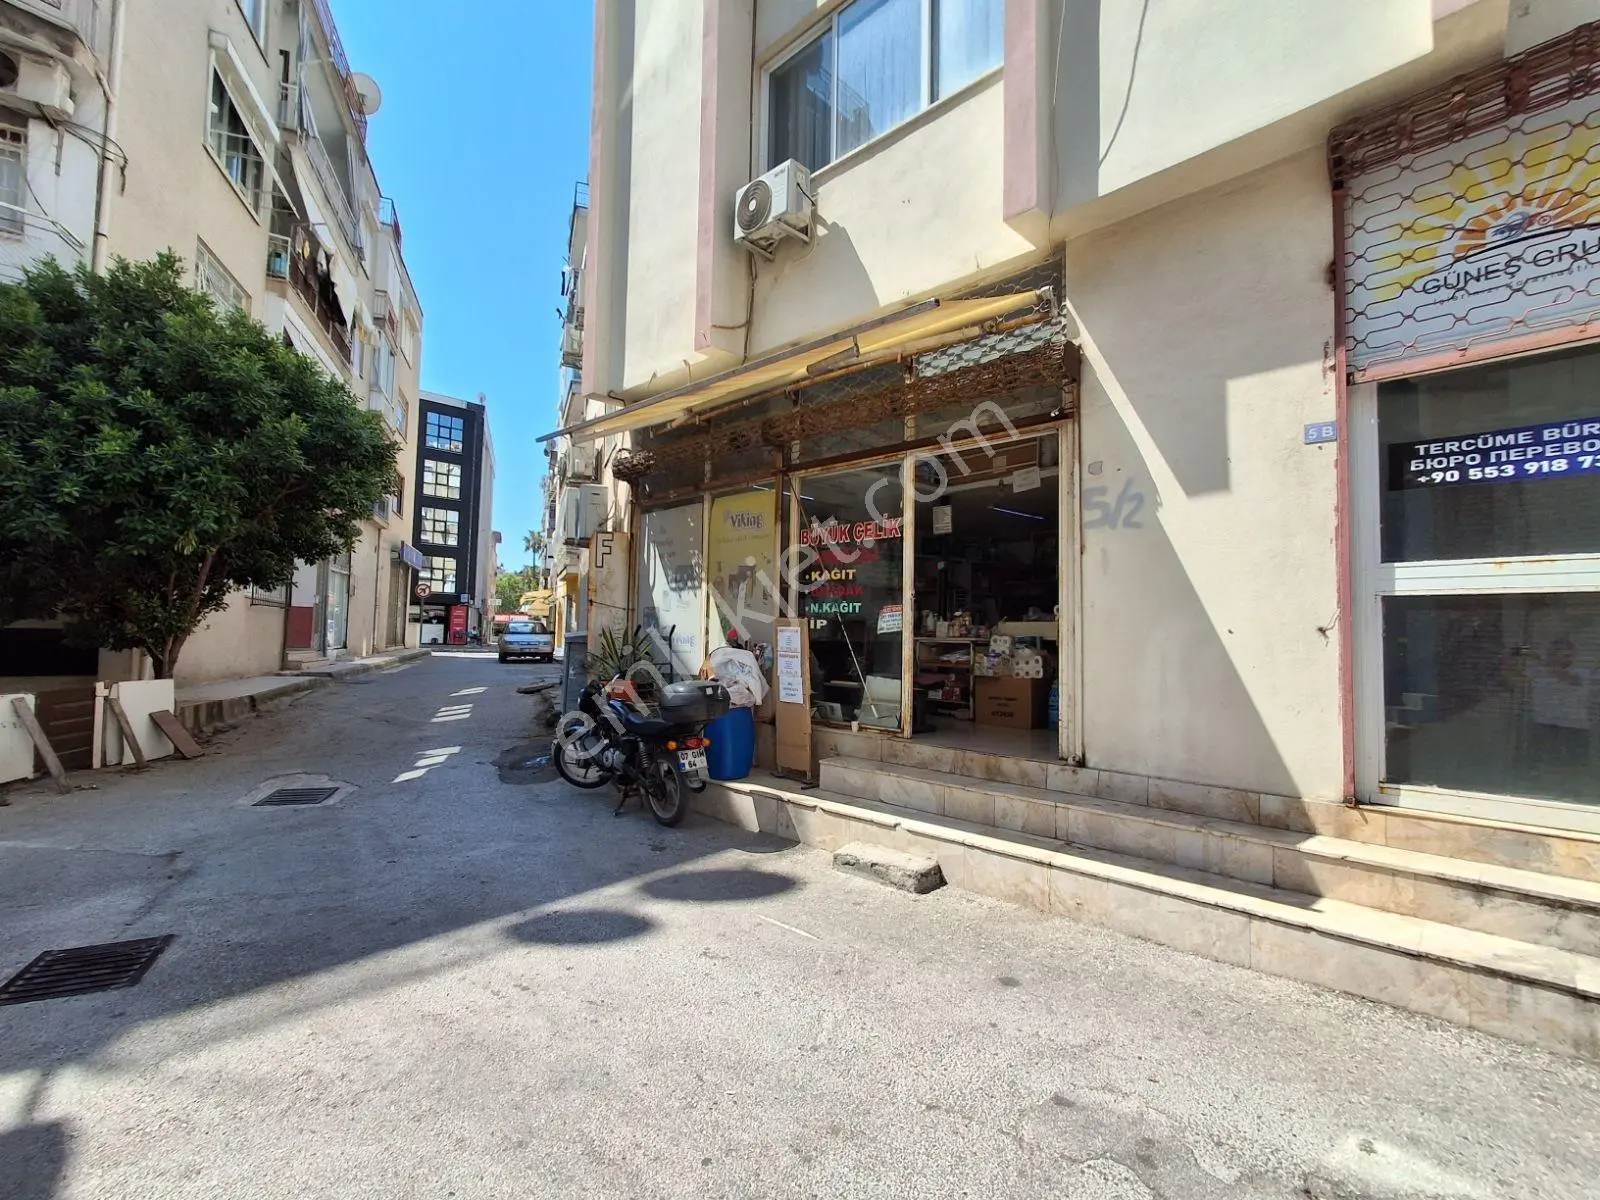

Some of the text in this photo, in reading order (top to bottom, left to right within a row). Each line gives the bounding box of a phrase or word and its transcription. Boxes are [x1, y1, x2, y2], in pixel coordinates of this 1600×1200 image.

[1423, 257, 1522, 295] GÜNEŞ
[1308, 426, 1333, 439] 5 B
[1415, 422, 1600, 456] TERCÜME BÜR
[1410, 438, 1600, 472] БЮРО ПЕРЕВО
[1417, 470, 1460, 484] +90
[1468, 464, 1515, 480] 553
[1523, 457, 1569, 474] 918
[800, 521, 851, 547] BÜYÜK
[852, 513, 903, 546] ÇELİK
[595, 531, 615, 569] F
[811, 567, 857, 582] KAĞIT
[809, 600, 862, 614] N.KAĞIT
